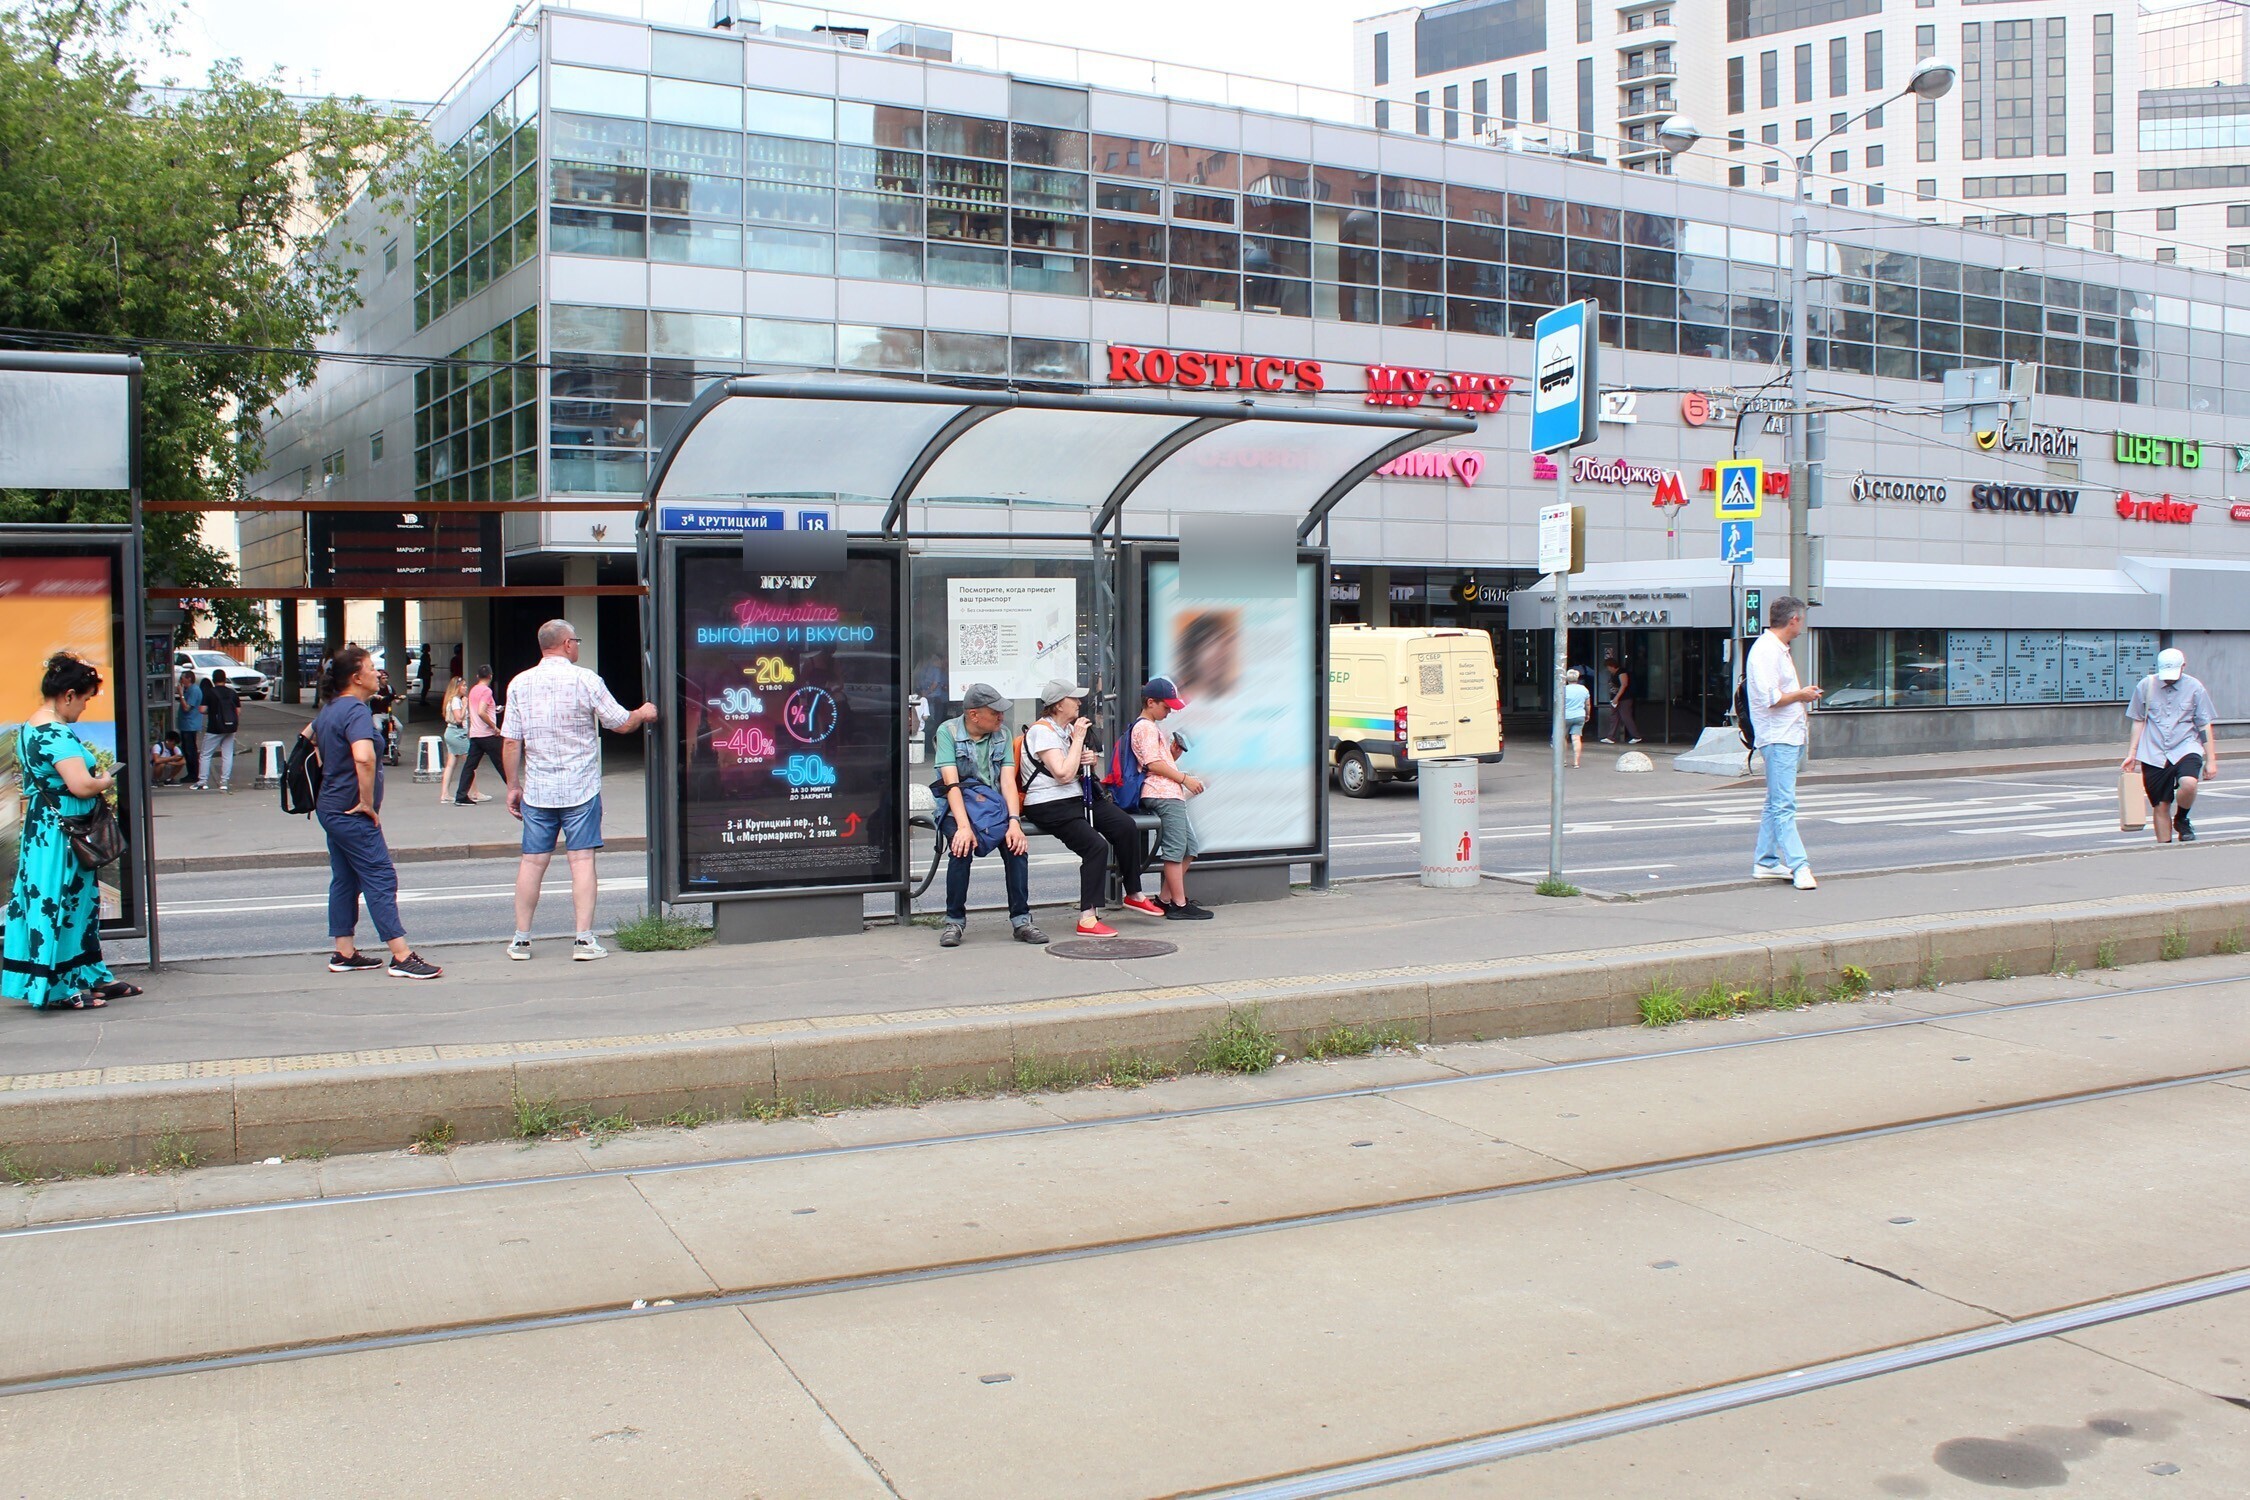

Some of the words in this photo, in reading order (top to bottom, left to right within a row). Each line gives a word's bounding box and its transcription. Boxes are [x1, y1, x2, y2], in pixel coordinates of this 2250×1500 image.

[1107, 345, 1324, 392] ROSTIC'S
[2115, 429, 2202, 469] ЦВЕТЫ
[1574, 456, 1661, 487] Подружка
[1972, 484, 2079, 514] SOKOLOV
[699, 516, 768, 528] КРУТИЦКИЙ
[806, 518, 825, 531] 18
[735, 600, 839, 630] Ужинайте
[1554, 610, 1671, 625] ОЛЕТАРСКАЯ
[697, 627, 780, 644] ВЫГОДНО
[787, 627, 799, 642] И
[806, 626, 874, 642] ВКУСНО
[743, 656, 795, 683] -20%
[1329, 671, 1351, 683] БЕР
[708, 687, 764, 713] -30%
[712, 727, 775, 756] -40%
[771, 755, 836, 785] -50%
[721, 832, 734, 844] ТЦ
[736, 830, 806, 843] «Метромаркет»,
[809, 829, 814, 838] 2
[817, 828, 837, 838] этаж
[727, 819, 743, 830] 3-й
[745, 817, 791, 831] Крутицкий
[793, 818, 814, 829] пер.,
[817, 816, 831, 826] 18,
